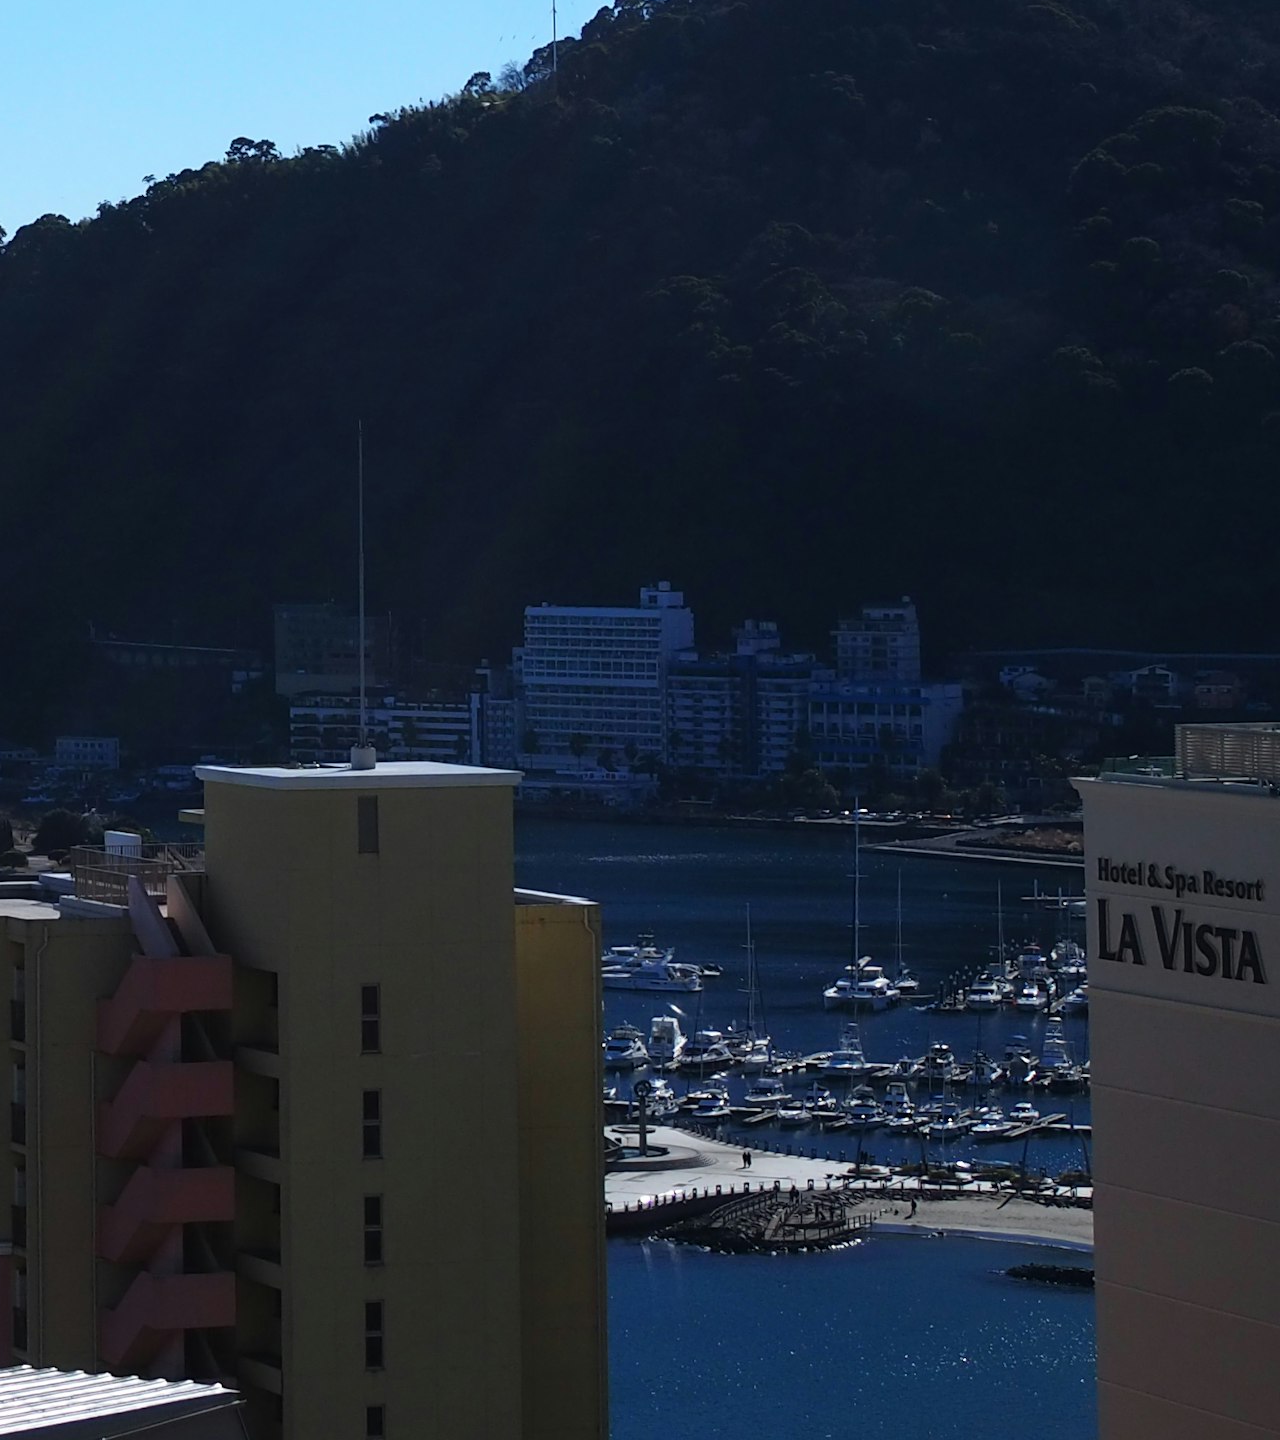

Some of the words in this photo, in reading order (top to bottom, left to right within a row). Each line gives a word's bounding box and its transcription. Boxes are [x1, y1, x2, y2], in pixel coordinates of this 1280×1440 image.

[1097, 857, 1144, 886] Hotel
[1147, 864, 1163, 889] &
[1165, 866, 1198, 897] Spa
[1203, 871, 1263, 902] Resort
[1097, 899, 1144, 966] LA
[1151, 906, 1267, 985] VISTA
